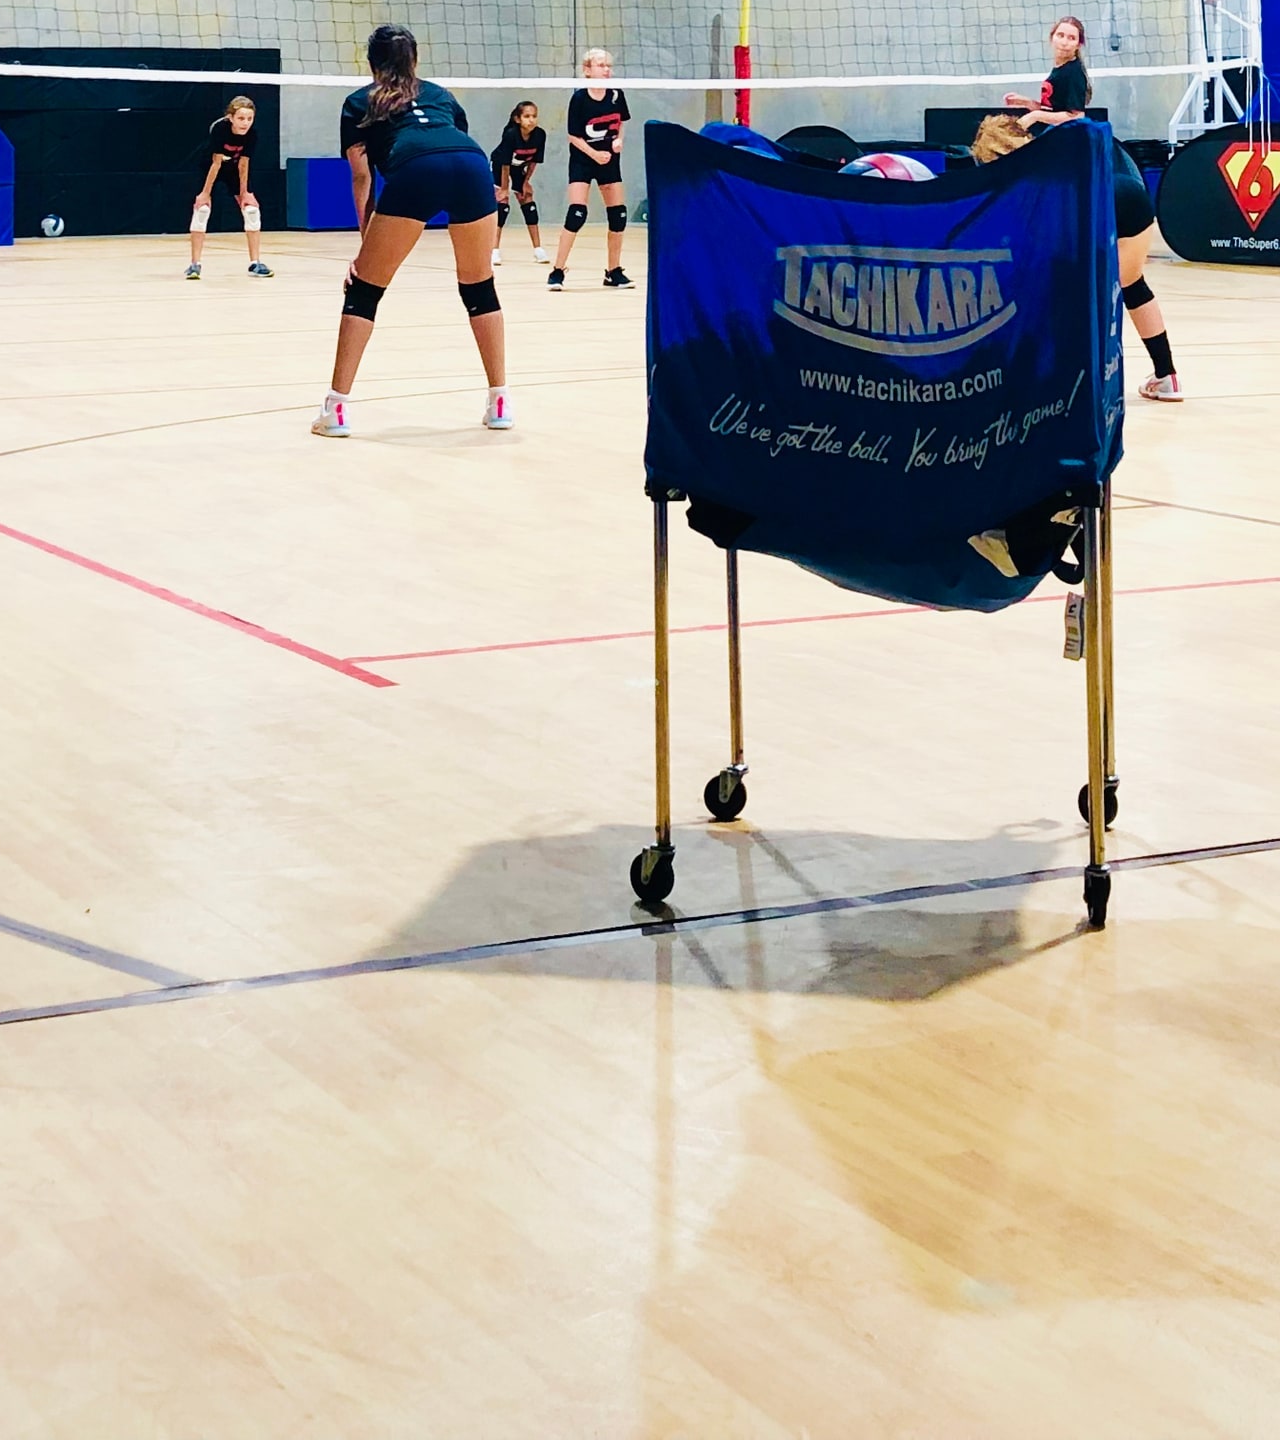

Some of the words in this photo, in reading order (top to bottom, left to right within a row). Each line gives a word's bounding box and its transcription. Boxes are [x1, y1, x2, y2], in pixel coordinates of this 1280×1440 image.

[775, 246, 1005, 337] TACHIKARA
[709, 393, 771, 441] We've
[770, 422, 815, 457] got
[811, 424, 843, 454] the
[847, 430, 892, 464] ball.
[904, 427, 937, 473] You
[944, 435, 989, 470] bring
[1019, 369, 1085, 444] game!
[799, 367, 1003, 403] www.tachikara.com
